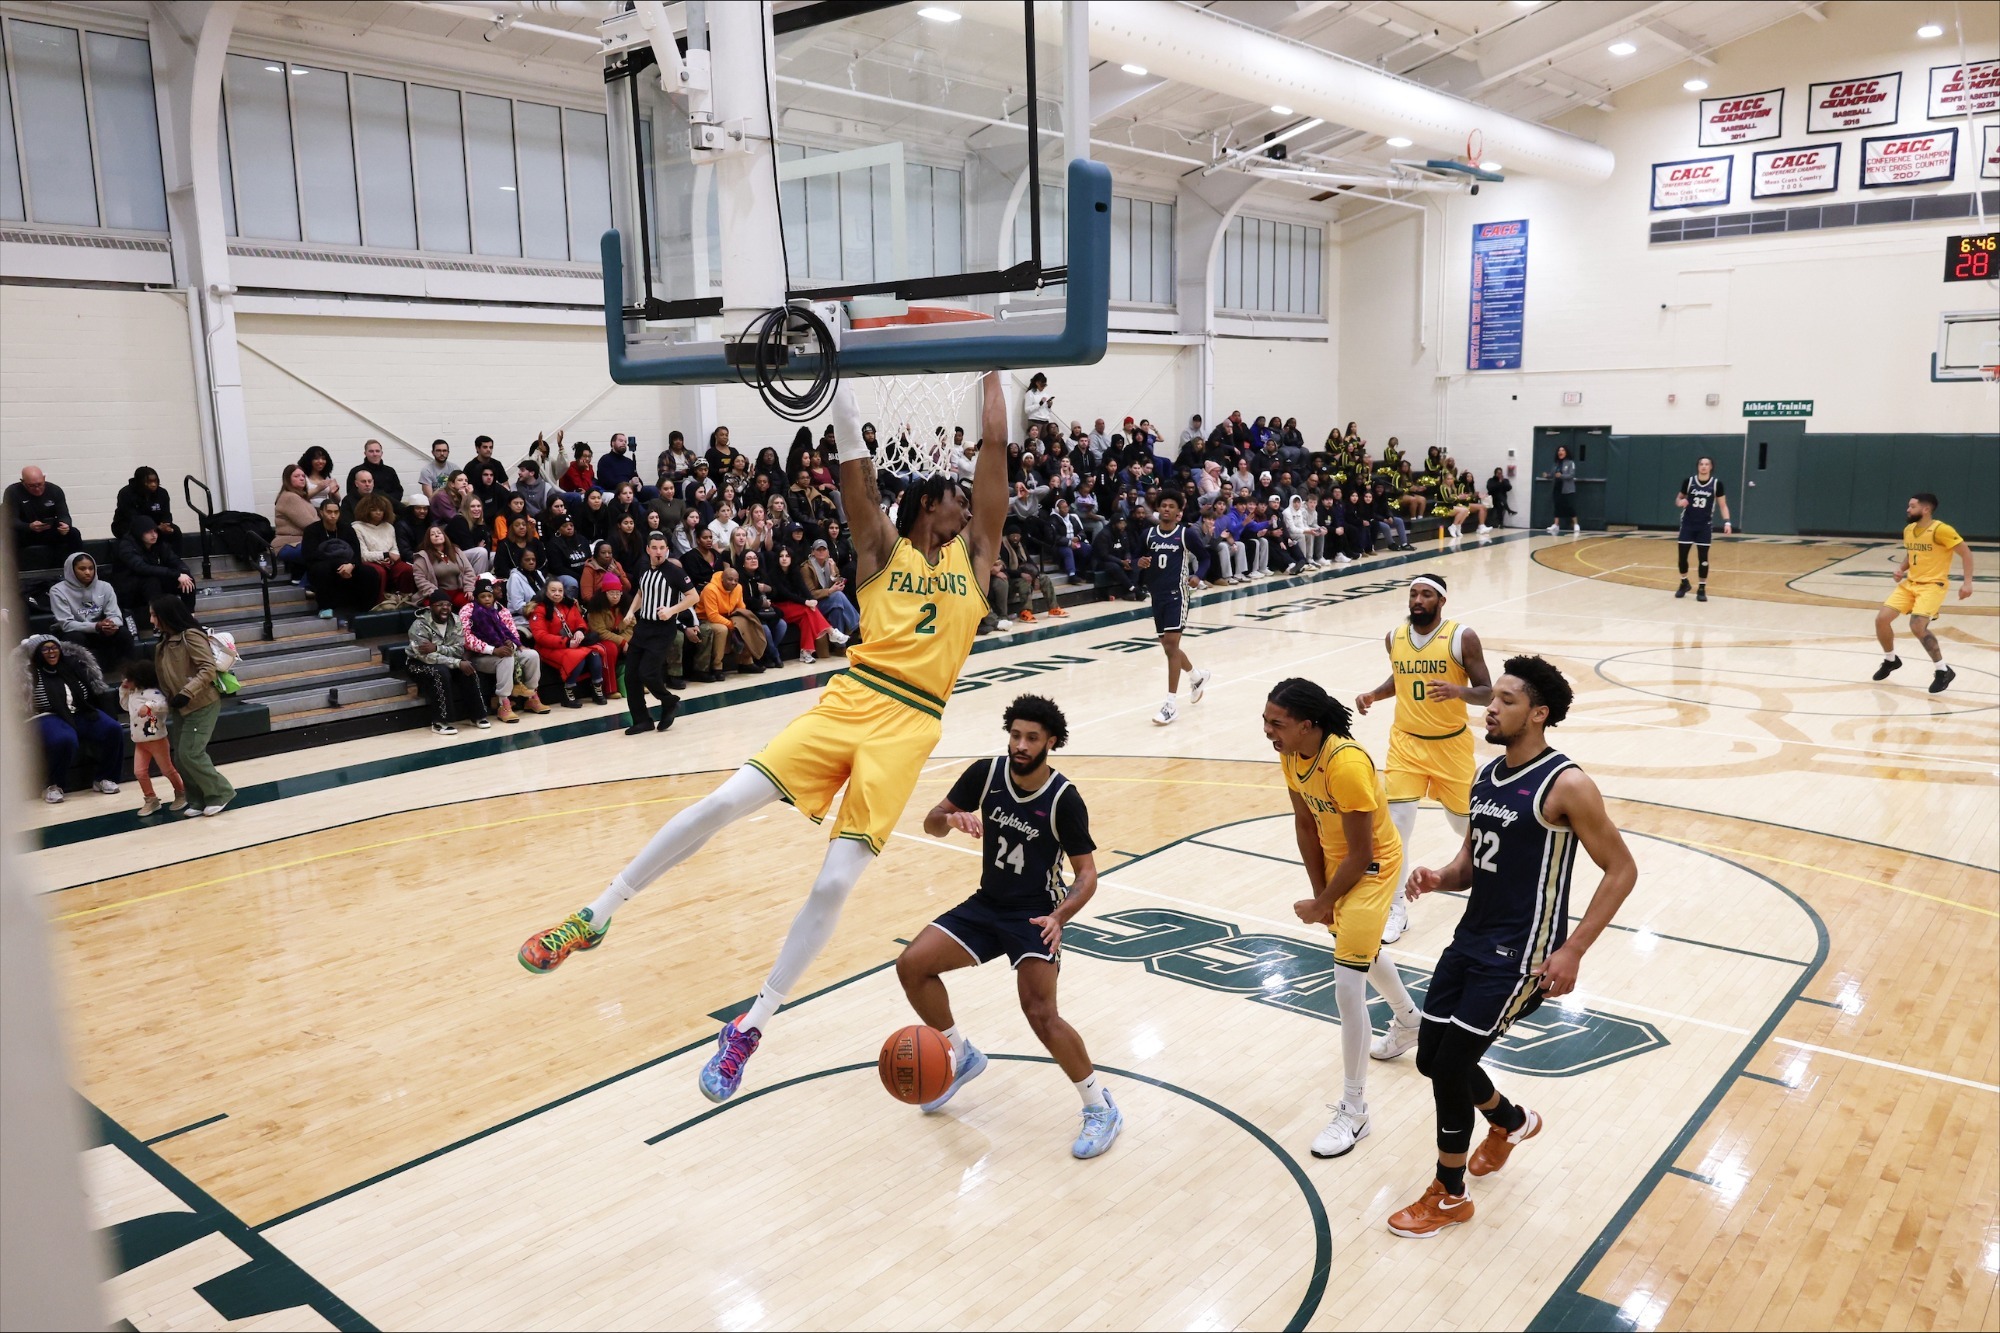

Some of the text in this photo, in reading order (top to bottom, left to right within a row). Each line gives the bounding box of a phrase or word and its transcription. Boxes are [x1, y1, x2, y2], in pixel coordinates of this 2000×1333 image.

[1829, 81, 1879, 98] CACC
[1719, 97, 1765, 114] CACC
[1820, 93, 1887, 109] CHAMPION
[1710, 108, 1772, 123] CHAMPION
[1833, 108, 1872, 118] BASEBALL
[1721, 123, 1757, 132] BASEBALL
[1883, 138, 1934, 155] CACC
[1771, 152, 1819, 169] CACC
[1867, 150, 1950, 165] CONFERENCE CHAMPION
[1670, 166, 1713, 181] CACC
[1867, 159, 1949, 173] MEN'S CROSS COUNTRY
[1893, 171, 1920, 179] 2007
[1481, 223, 1520, 237] CACC
[1961, 237, 1996, 252] 6:46
[1956, 252, 1989, 277] 28
[1744, 402, 1812, 412] Athletic Training
[1692, 497, 1707, 508] 33
[1150, 541, 1180, 553] Lightning
[1158, 553, 1168, 569] 0
[1913, 554, 1917, 566] 1
[887, 571, 967, 596] FALCONS
[915, 602, 937, 634] 2
[1393, 660, 1447, 674] FALCONS
[1413, 680, 1425, 701] 0
[1469, 795, 1519, 828] Lightning
[989, 806, 1040, 841] Lightning
[994, 835, 1025, 875] 24
[1472, 828, 1501, 873] 22
[897, 1036, 914, 1061] THE
